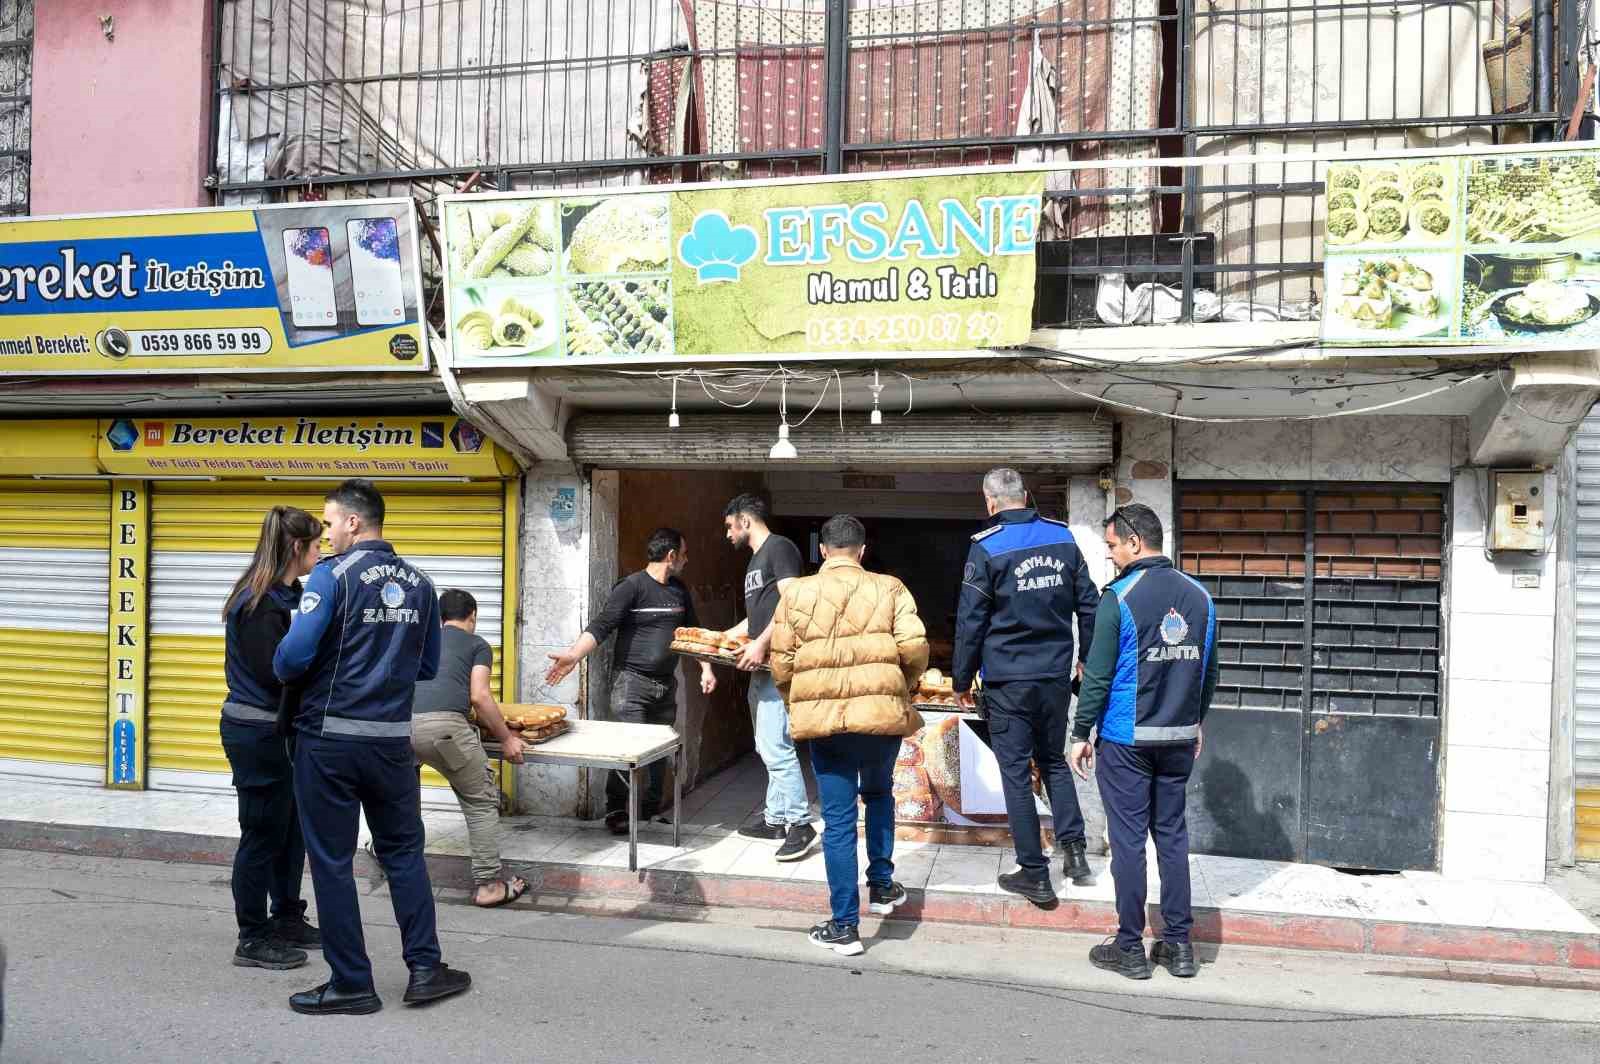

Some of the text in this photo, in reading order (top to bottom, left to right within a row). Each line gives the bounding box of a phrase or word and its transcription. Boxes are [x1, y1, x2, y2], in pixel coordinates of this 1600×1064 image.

[764, 194, 1042, 266] EFSANE
[145, 259, 264, 296] İletişim
[808, 264, 998, 304] Mamul & Tatlı
[35, 335, 91, 354] Bereket:
[141, 334, 179, 351] 0539
[184, 334, 213, 351] 866
[217, 333, 237, 350] 59
[241, 332, 262, 349] 99
[171, 421, 286, 445] Bereket
[292, 417, 414, 450] İletişim
[360, 564, 420, 588] SEYHAN
[1014, 555, 1064, 578] SEYHAN
[1017, 574, 1064, 592] ZABITA
[116, 489, 137, 714] BEREKET
[363, 608, 420, 624] ZABITA
[1146, 645, 1201, 662] ZABITA
